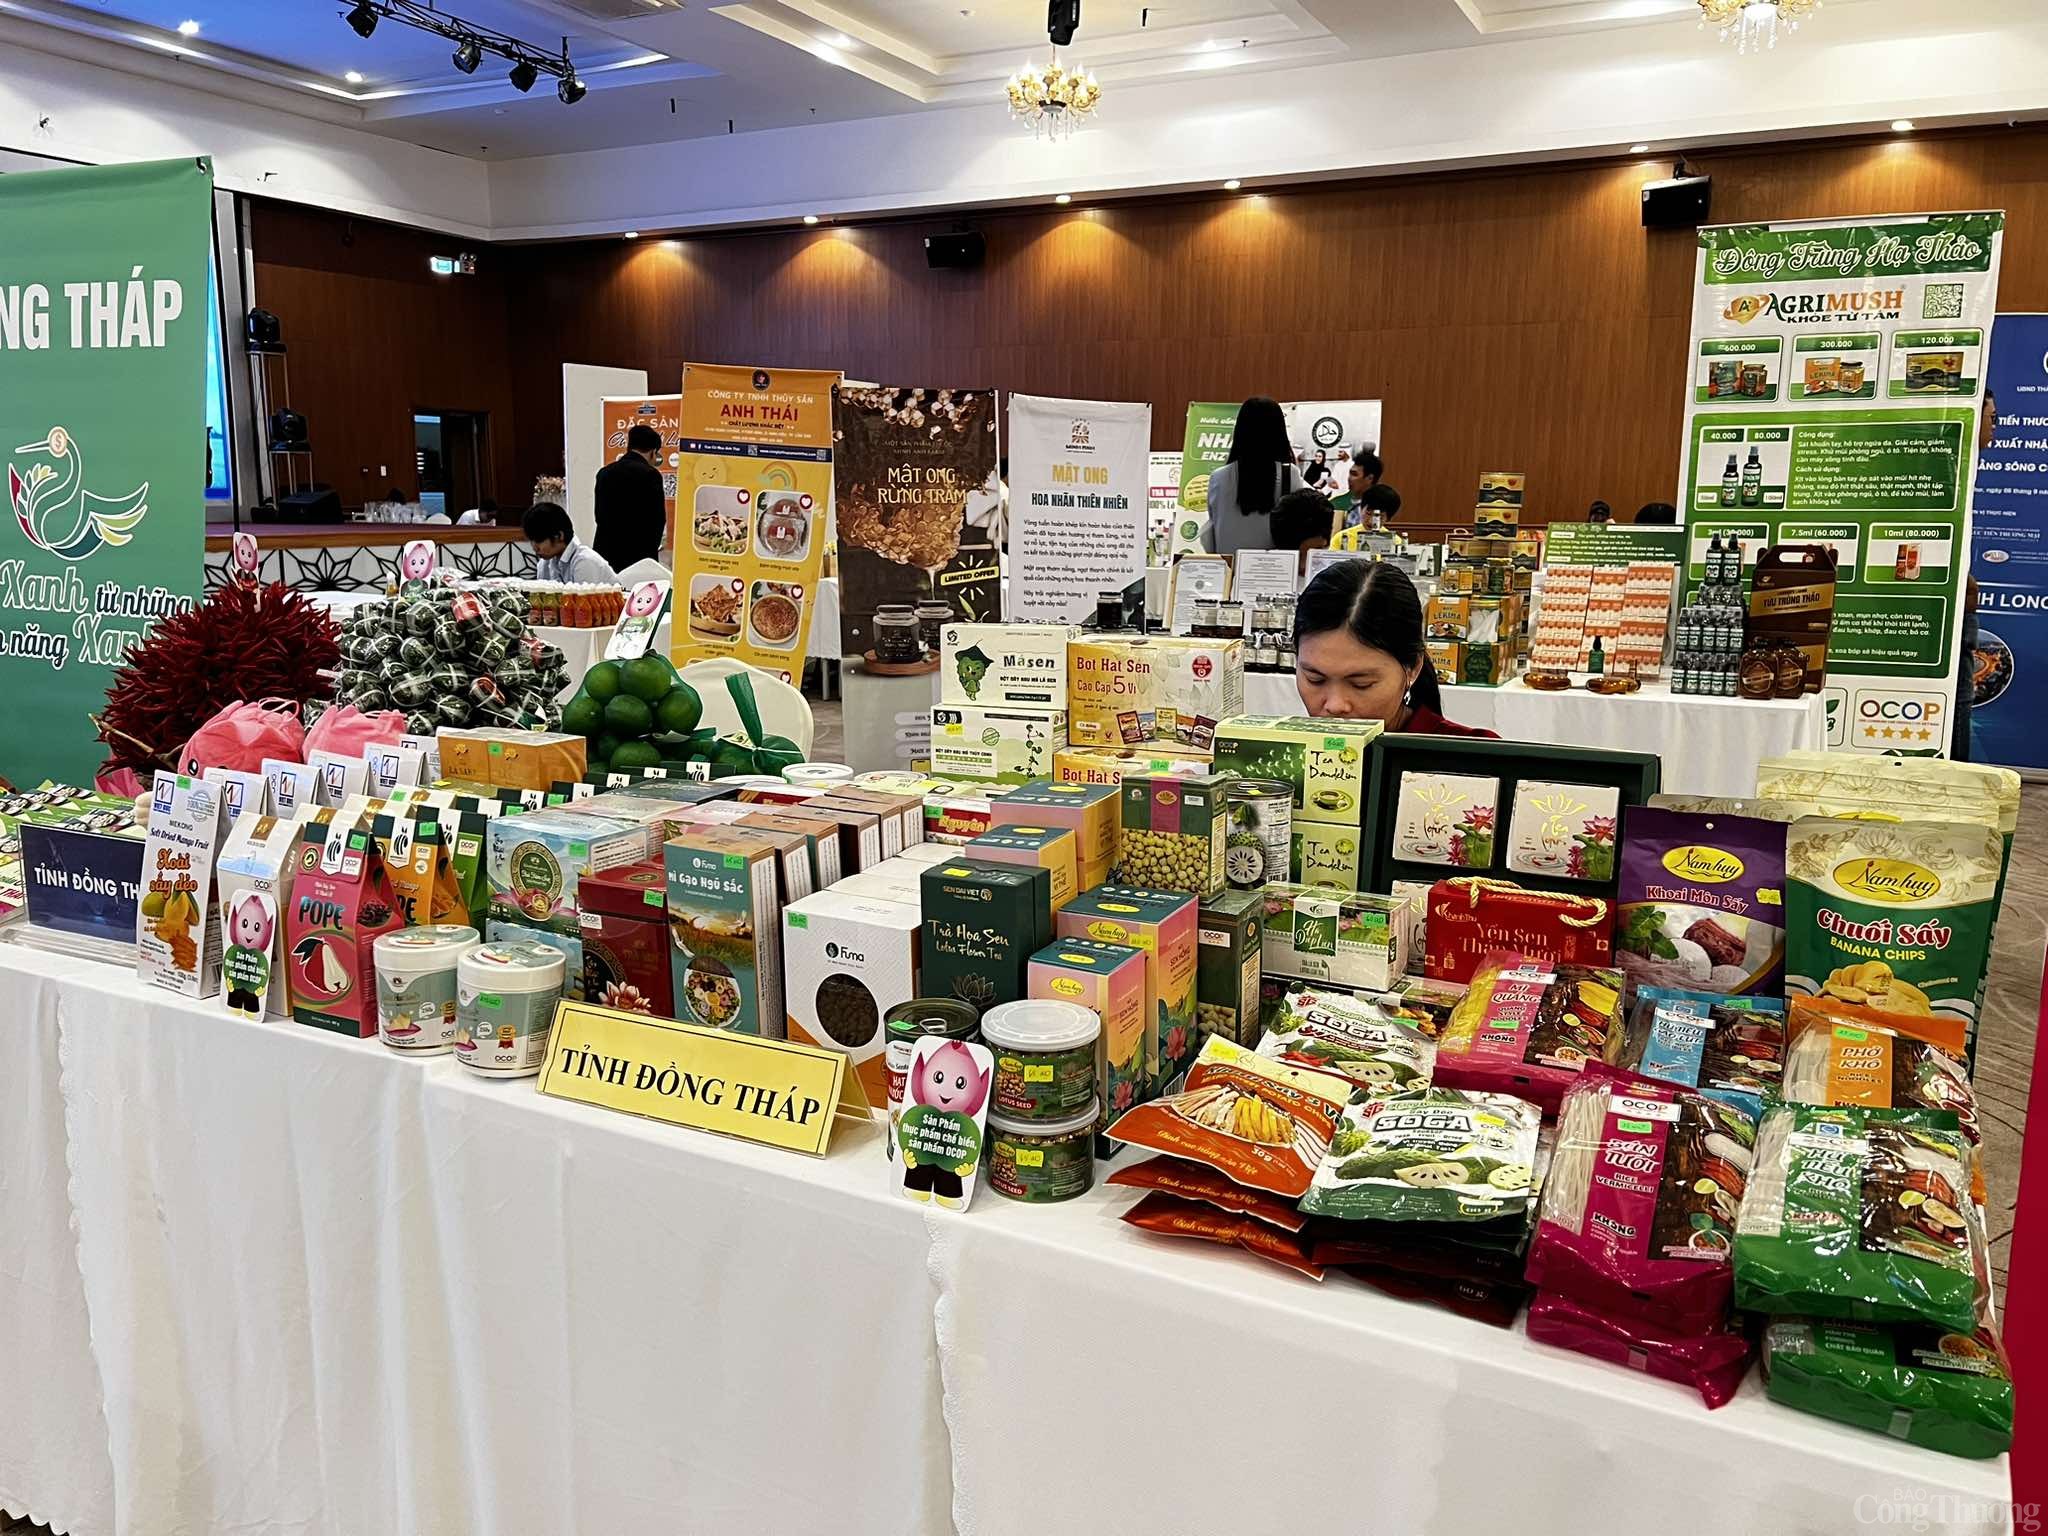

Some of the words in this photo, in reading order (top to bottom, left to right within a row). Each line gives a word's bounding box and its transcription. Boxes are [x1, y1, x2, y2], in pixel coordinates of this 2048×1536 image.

[1713, 246, 1785, 280] Đông
[1865, 238, 1912, 269] Hạ
[1914, 231, 1981, 266] Thảo
[64, 265, 183, 349] THÁP
[1765, 289, 1904, 321] AGRIMUSH
[1820, 340, 1852, 349] 300.000
[1921, 336, 1954, 345] 120.000
[707, 390, 731, 400] CÔNG
[735, 392, 744, 400] TY
[748, 392, 768, 401] TNHH
[797, 395, 814, 404] SẢN
[721, 404, 754, 418] ANH
[761, 403, 798, 421] THÁI
[1998, 414, 2020, 425] TIẾN
[1711, 432, 1737, 440] 40.000
[1995, 437, 2023, 448] XUẤT
[888, 463, 921, 487] MẬT
[926, 468, 955, 483] ONG
[1052, 462, 1079, 486] MẬT
[1084, 467, 1108, 484] ONG
[2004, 461, 2036, 472] SÔNG
[878, 484, 922, 503] RỪNG
[1032, 493, 1048, 506] HOA
[1051, 492, 1075, 507] NHÃN
[1077, 494, 1101, 508] THIÊN
[1103, 495, 1128, 509] NHIÊN
[1791, 529, 1813, 537] 7.5ml
[1815, 528, 1847, 538] (60.000)
[1884, 529, 1903, 537] 10ml
[1905, 529, 1940, 538] (80.000)
[945, 572, 972, 583] LIMITED
[974, 569, 995, 579] OFFER
[97, 582, 119, 613] từ
[10, 624, 68, 669] năng
[1077, 657, 1096, 671] Bot
[1101, 658, 1122, 673] Hat
[1127, 660, 1151, 674] Sen
[1077, 680, 1093, 692] Cao
[1095, 681, 1111, 695] Cap
[1113, 675, 1126, 694] 5
[1860, 700, 1940, 721] OCOP
[1310, 750, 1333, 765] Tea
[1063, 768, 1082, 782] Bot
[1087, 769, 1107, 784] Hat
[169, 820, 193, 831] MEKONG
[161, 830, 175, 841] Dried
[194, 839, 209, 850] Fruit
[1307, 841, 1330, 855] Tea
[157, 848, 191, 870] Xoài
[1673, 848, 1712, 870] Nam
[1713, 857, 1740, 878] huy
[34, 863, 68, 890] TỈNH
[72, 868, 118, 897] ĐỒNG
[149, 871, 173, 900] sấy
[174, 873, 199, 892] dẻo
[679, 873, 698, 888] Gạo
[700, 876, 721, 891] Ngũ
[723, 878, 744, 894] Sắc
[1850, 860, 1900, 887] Nam
[1901, 872, 1936, 898] huy
[1646, 885, 1688, 900] Khoai
[1690, 888, 1720, 906] Môn
[1722, 894, 1749, 914] Sấy
[298, 896, 345, 931] POPE
[928, 920, 953, 937] Trà
[956, 923, 981, 942] Hoa
[982, 928, 1009, 946] Sen
[1514, 928, 1548, 946] Sen
[1817, 908, 1893, 945] Chuối
[1896, 918, 1952, 950] Sấy
[840, 946, 864, 962] Fuma
[1830, 936, 1881, 959] BANANA
[1884, 949, 1926, 961] CHIPS
[1306, 1010, 1388, 1042] SOGA
[1840, 1045, 1883, 1058] PHỞ
[1839, 1059, 1882, 1070] KHÔ
[561, 1043, 630, 1087] TỈNH
[633, 1061, 726, 1106] ĐỒNG
[735, 1083, 820, 1126] THÁP
[1261, 1087, 1302, 1107] POTATO
[1622, 1099, 1668, 1111] OCOP
[922, 1113, 938, 1126] Sản
[938, 1117, 961, 1132] Phẩm
[1372, 1114, 1472, 1132] SOGA
[902, 1122, 919, 1137] thực
[919, 1127, 941, 1141] phẩm
[942, 1133, 957, 1144] chế
[957, 1135, 977, 1150] biến,
[908, 1138, 923, 1150] sản
[922, 1142, 945, 1156] phẩm
[945, 1146, 967, 1160] OCOP
[1595, 1174, 1655, 1193] VERMICELLI
[1614, 1172, 1638, 1184] RICE
[1008, 1185, 1023, 1195] SEED
[1594, 1211, 1636, 1236] KHÔNG
